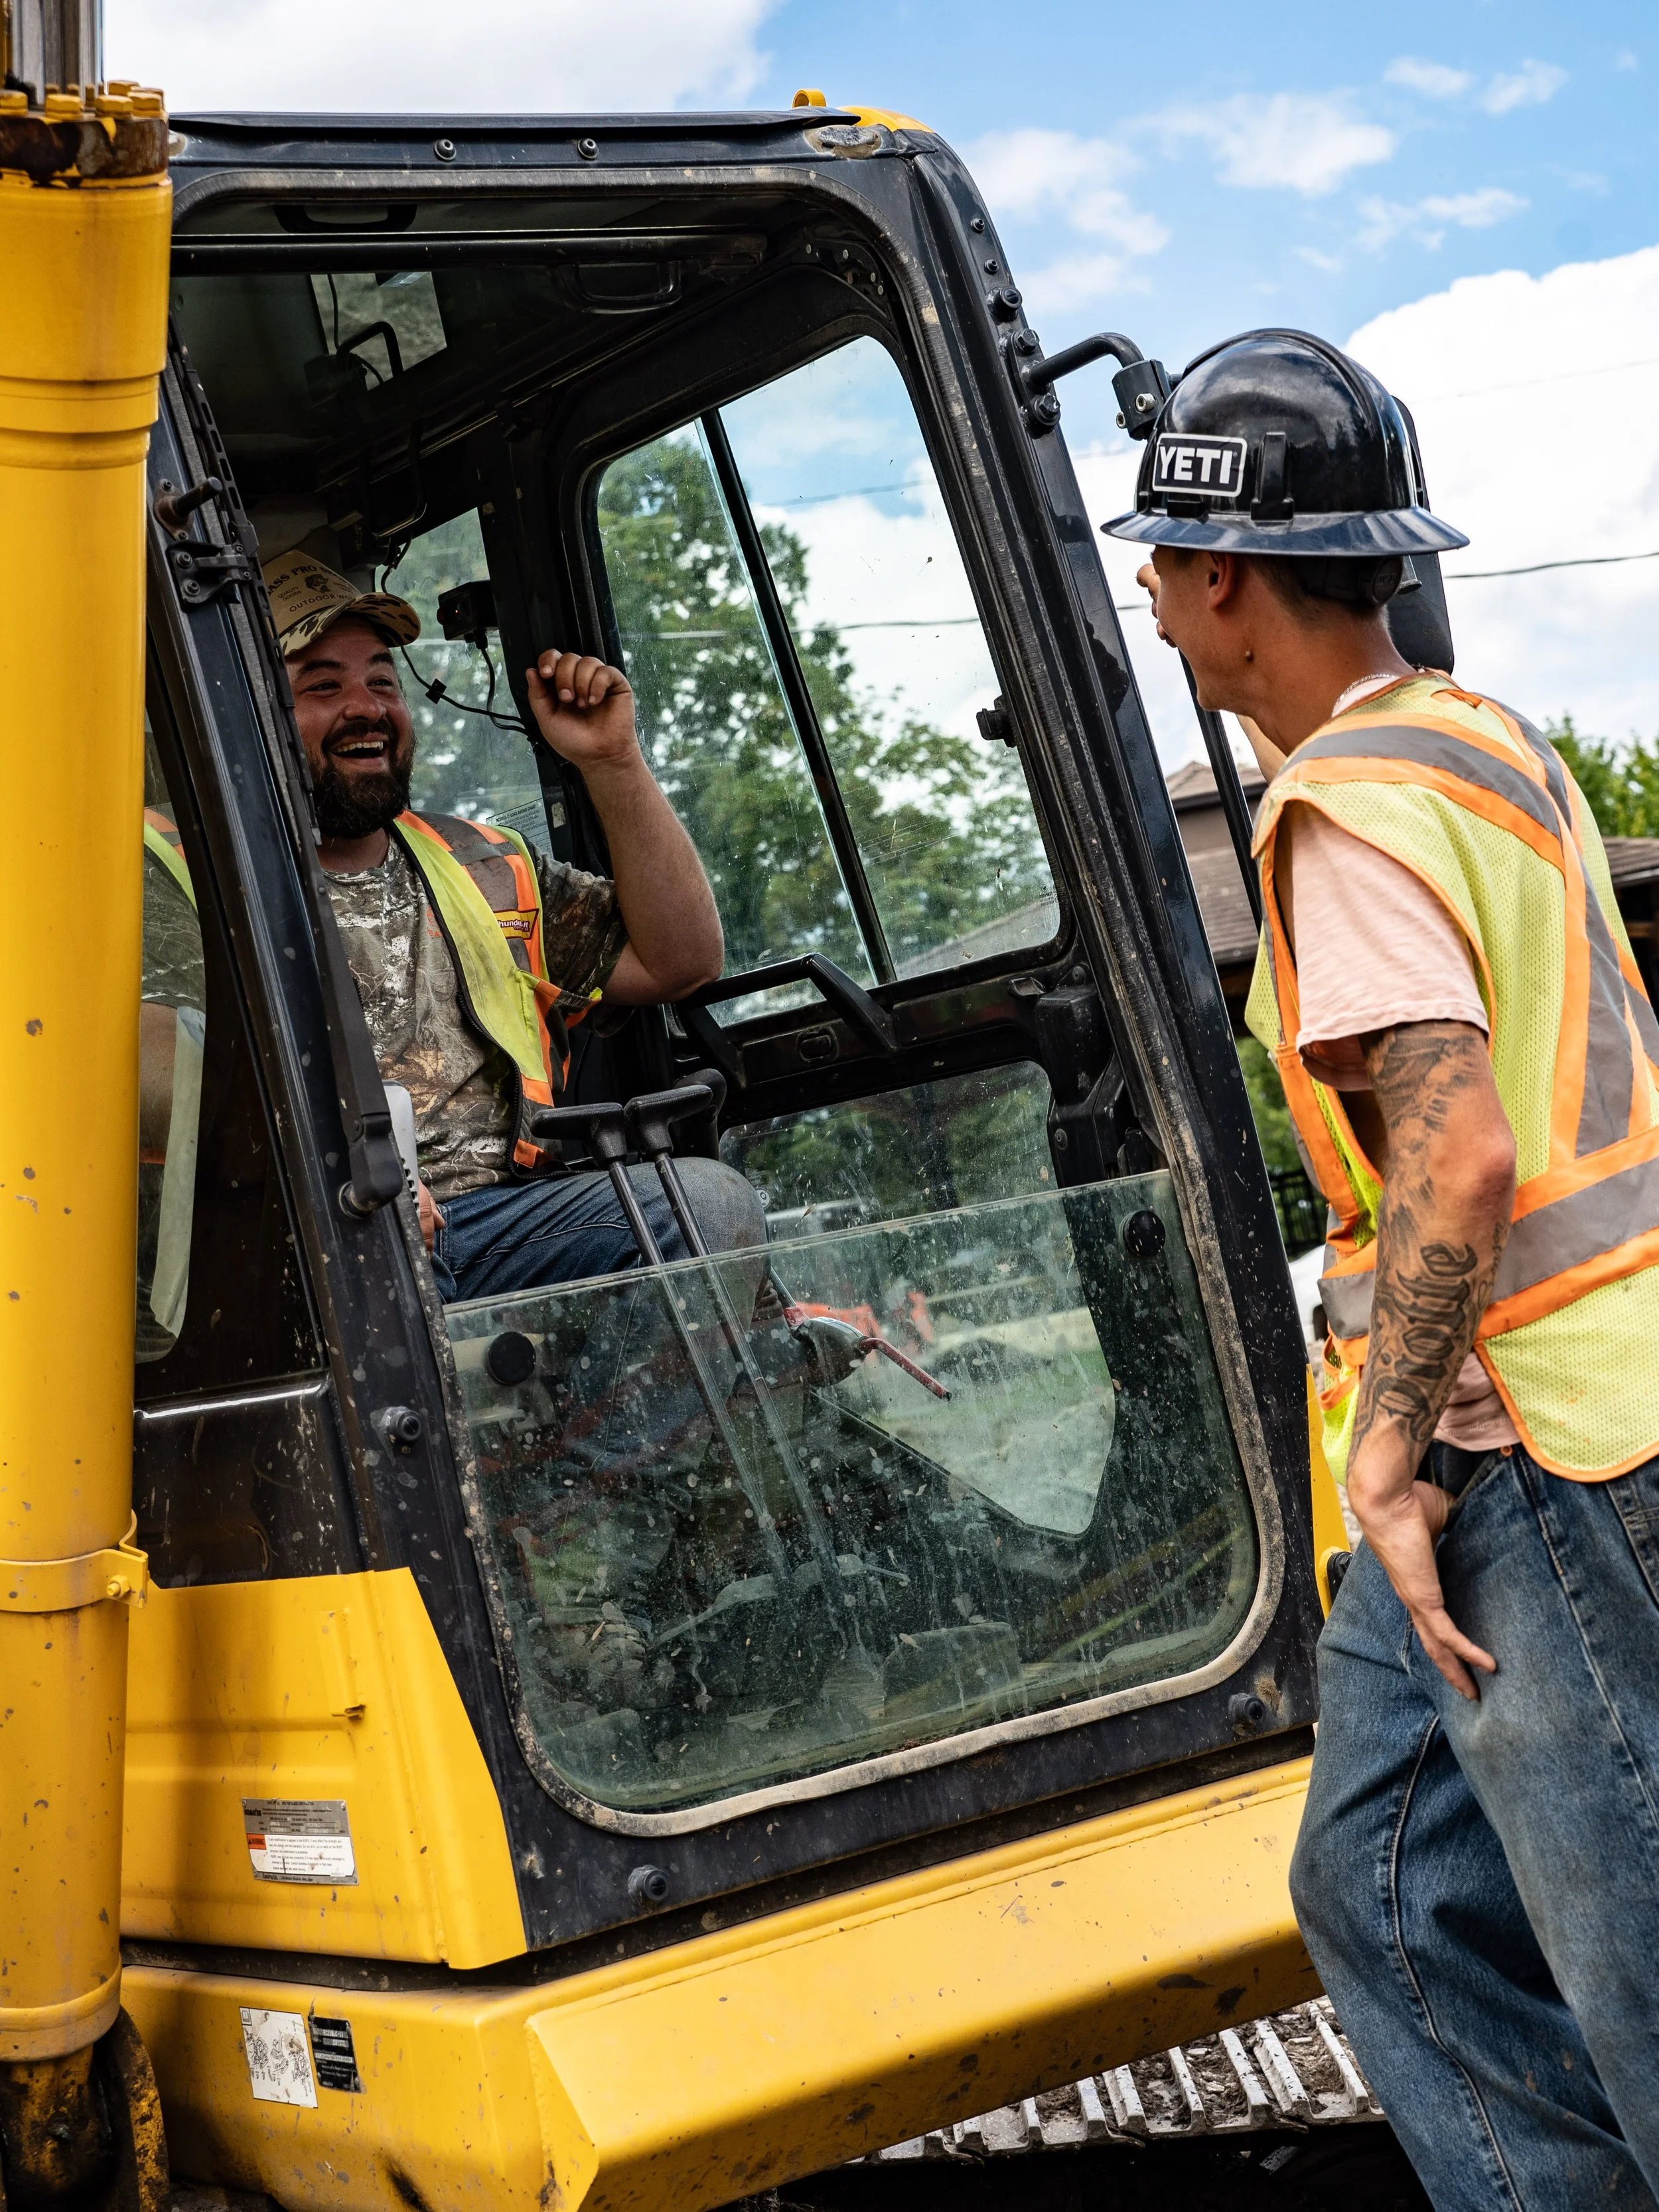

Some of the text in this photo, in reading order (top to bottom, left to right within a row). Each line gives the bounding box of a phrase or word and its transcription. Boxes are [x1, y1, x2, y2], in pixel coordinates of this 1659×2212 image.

[1159, 446, 1233, 484] YETI
[267, 573, 290, 597] ASS
[291, 565, 317, 576] PRO
[277, 585, 299, 598] QUALITY
[282, 590, 303, 602] GOODS
[289, 593, 335, 612] OUTDOOR
